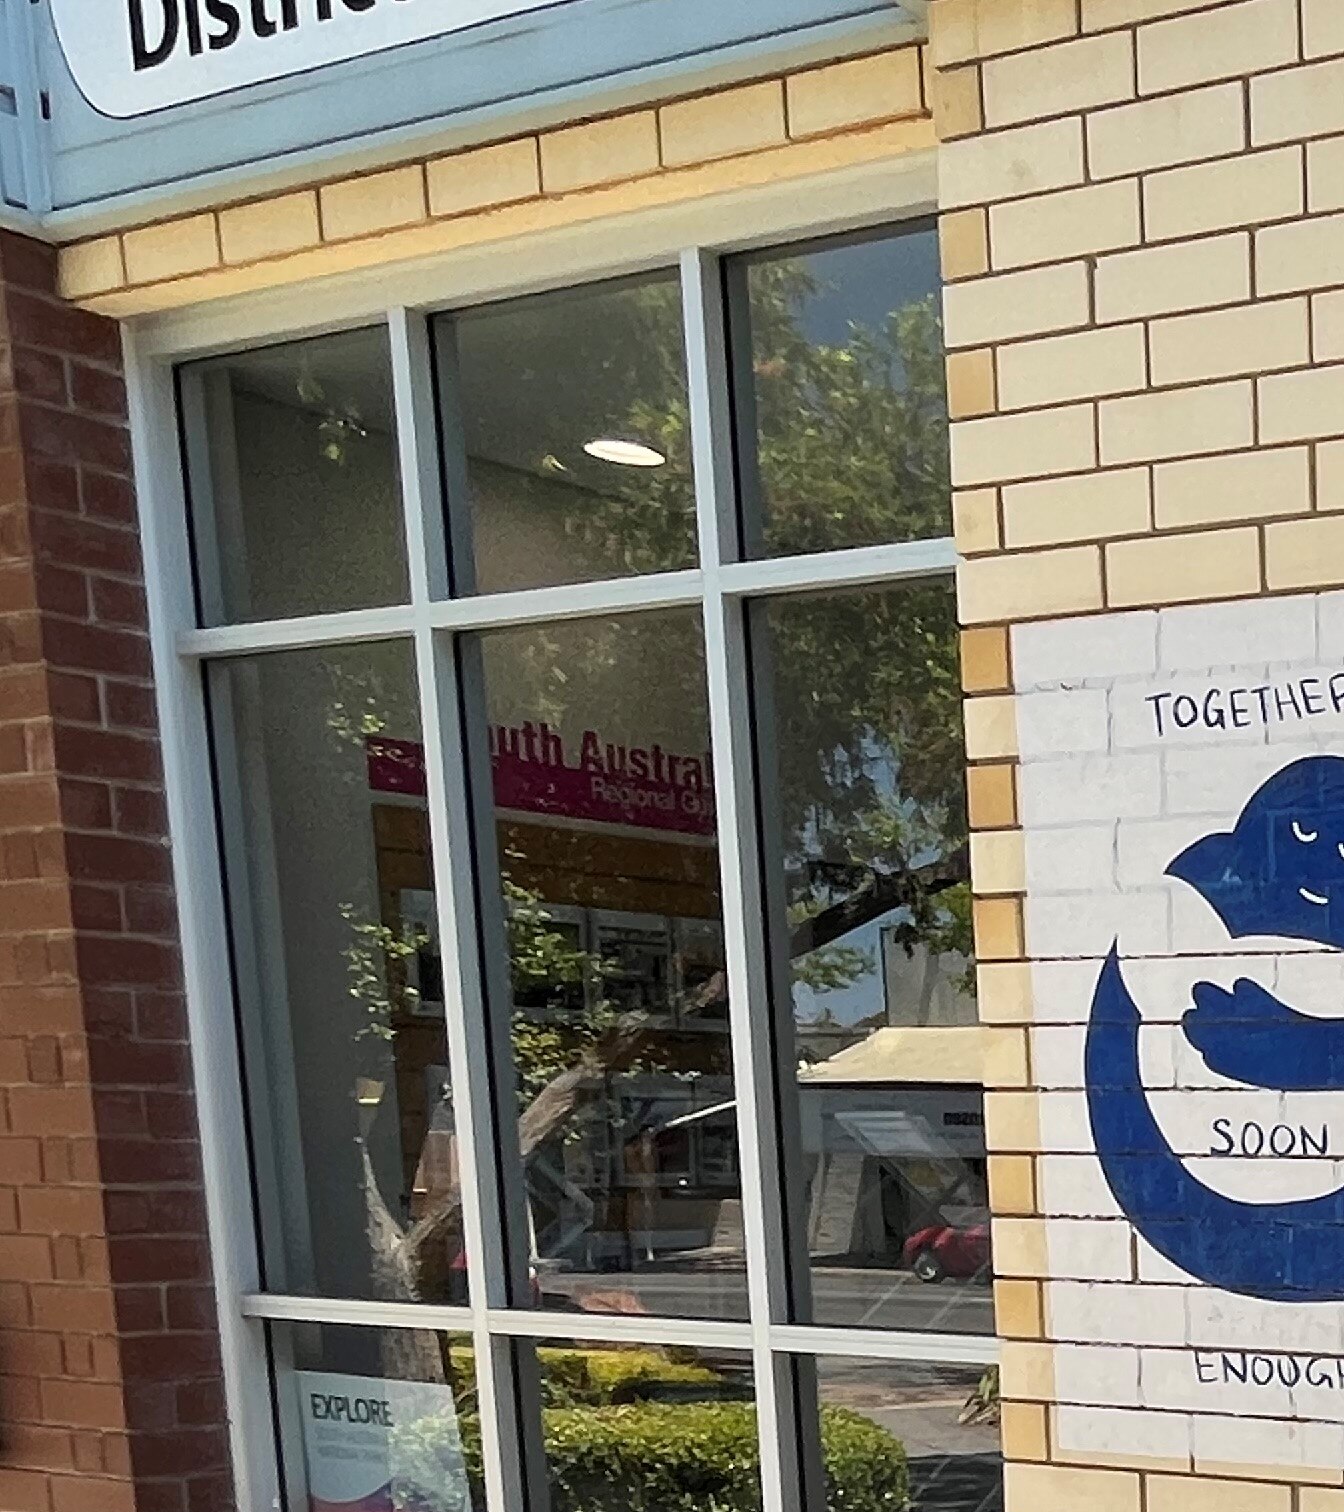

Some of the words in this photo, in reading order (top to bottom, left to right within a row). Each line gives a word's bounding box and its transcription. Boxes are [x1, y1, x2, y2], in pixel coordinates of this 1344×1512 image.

[488, 721, 563, 768] uth
[580, 730, 712, 789] Austral
[1209, 1118, 1330, 1157] SOON
[310, 1392, 395, 1427] EXPLORE
